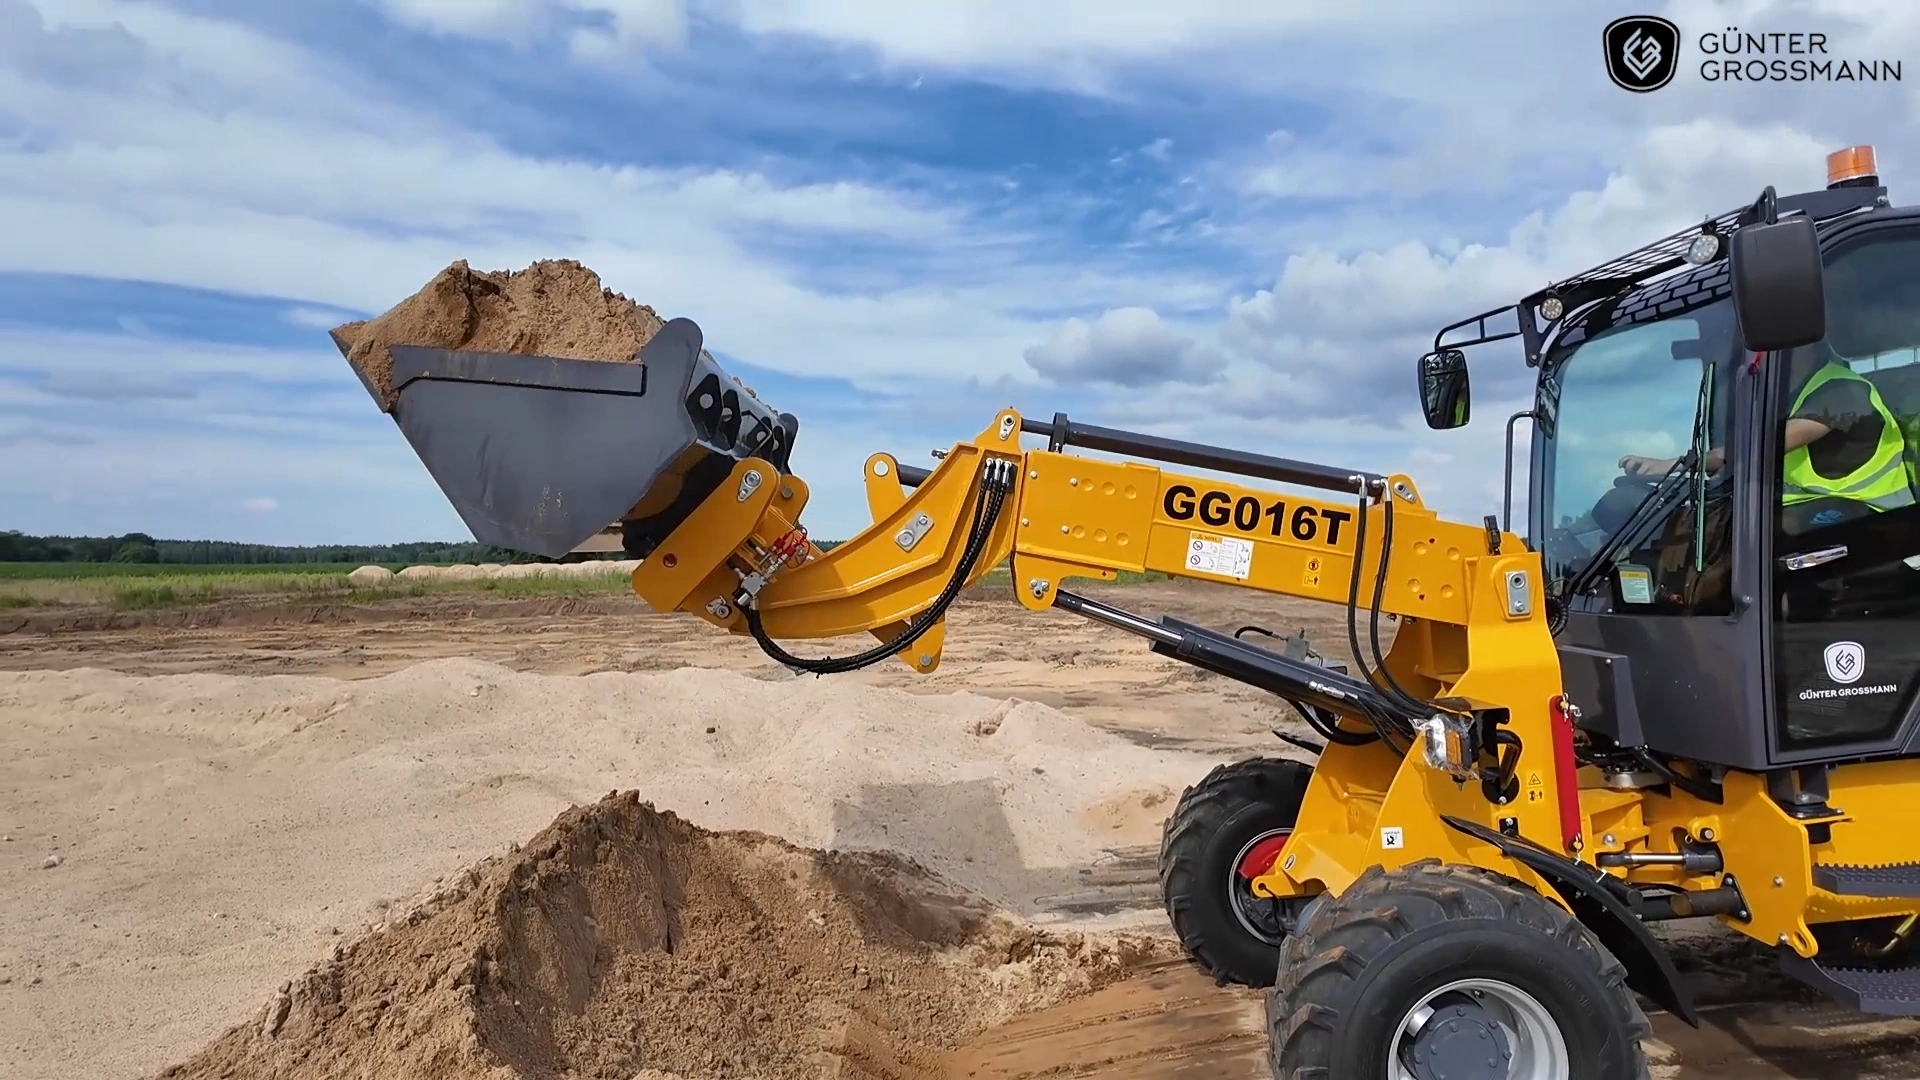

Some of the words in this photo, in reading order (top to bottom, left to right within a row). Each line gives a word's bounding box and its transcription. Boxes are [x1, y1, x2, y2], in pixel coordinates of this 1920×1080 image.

[1163, 485, 1351, 545] GG016T
[1799, 689, 1837, 700] GÜNTER
[1838, 684, 1897, 697] GROSSMANN
